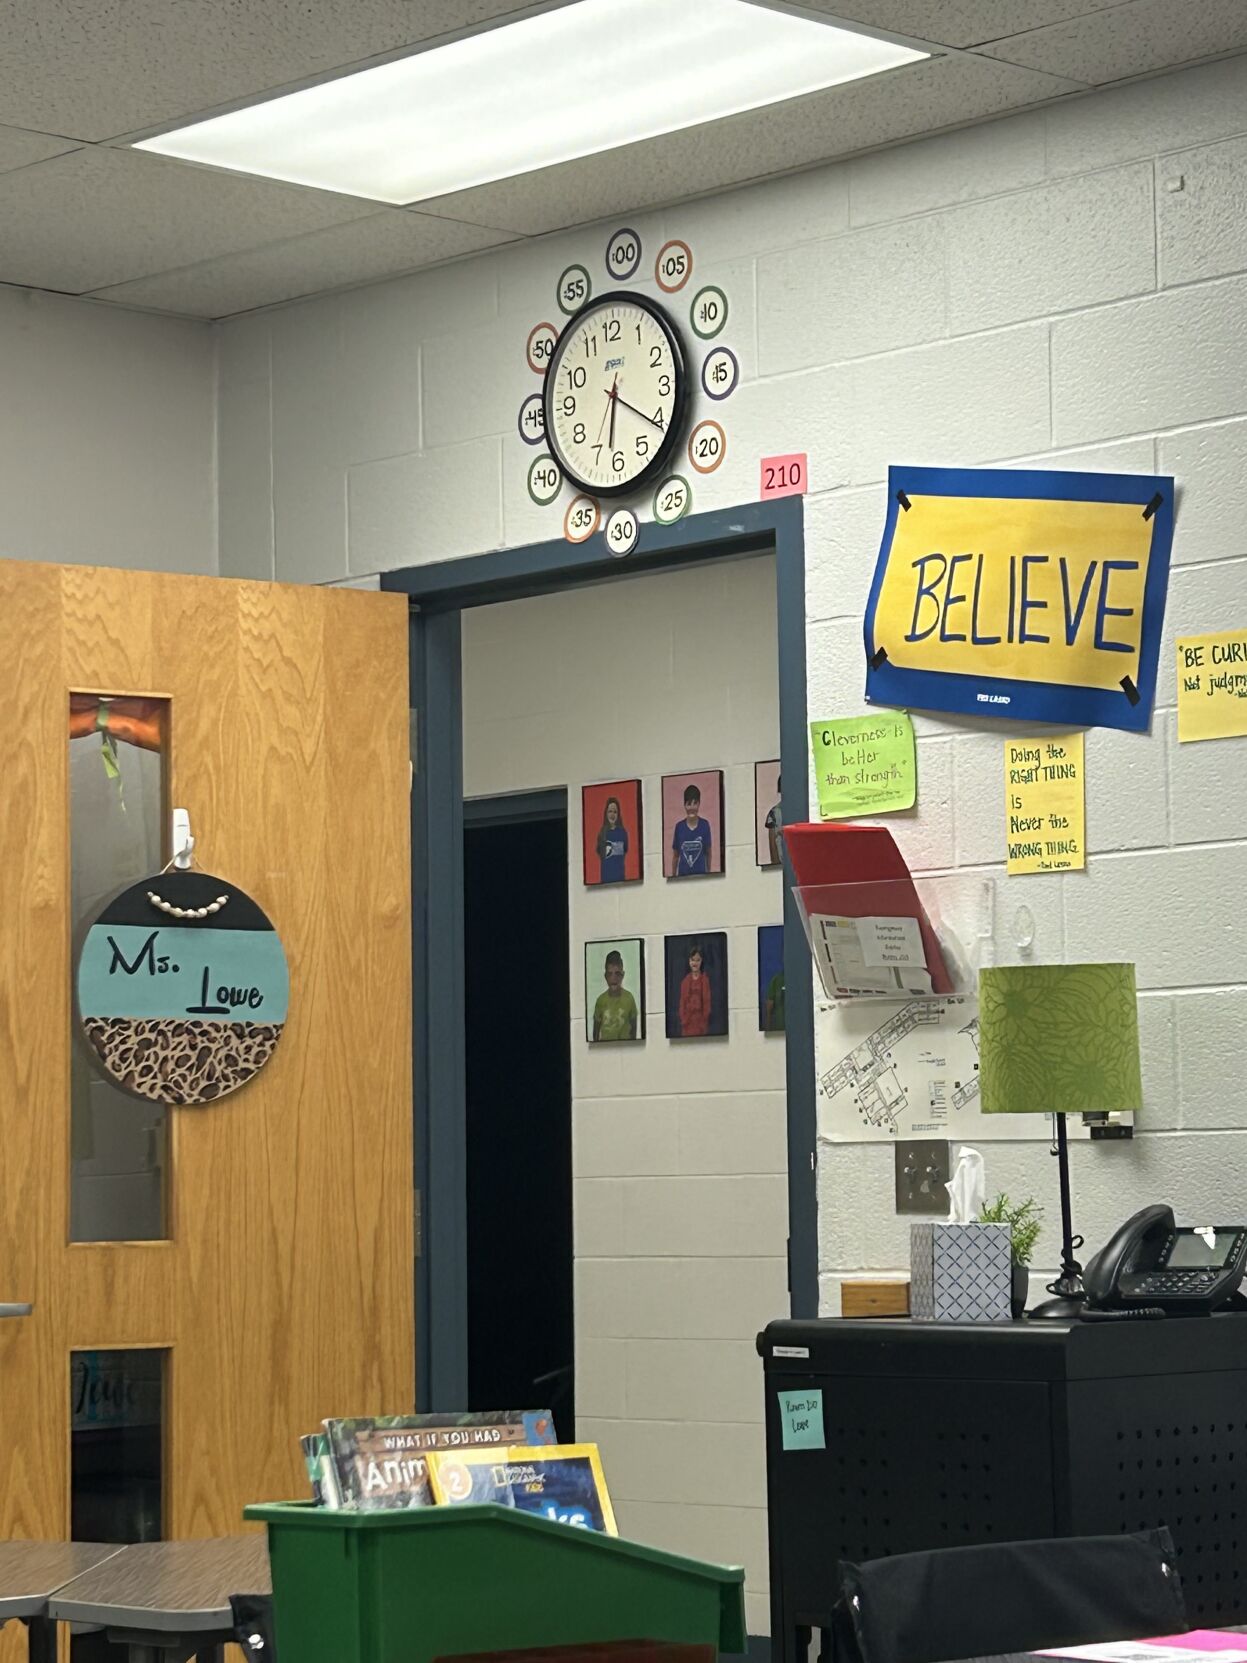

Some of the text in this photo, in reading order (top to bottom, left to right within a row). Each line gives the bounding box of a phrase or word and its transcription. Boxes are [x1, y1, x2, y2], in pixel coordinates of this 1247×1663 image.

[602, 320, 622, 343] 12
[635, 323, 641, 345] 1
[584, 335, 597, 358] 11
[649, 346, 662, 369] 2
[566, 366, 587, 391] 10
[658, 374, 671, 397] 3
[563, 395, 576, 417] 9
[651, 406, 664, 428] 4
[573, 423, 586, 444] 8
[591, 444, 603, 467] 7
[636, 435, 649, 457] 5
[612, 451, 625, 472] 6
[764, 463, 801, 490] 210
[904, 552, 1140, 653] BELIEVE
[1010, 747, 1041, 770] Doing
[1010, 815, 1045, 834] Never
[106, 930, 181, 976] Ms.
[185, 964, 264, 1015] Lowe
[383, 1429, 501, 1449] WHAT IF YOU HAD
[450, 1472, 461, 1493] 2
